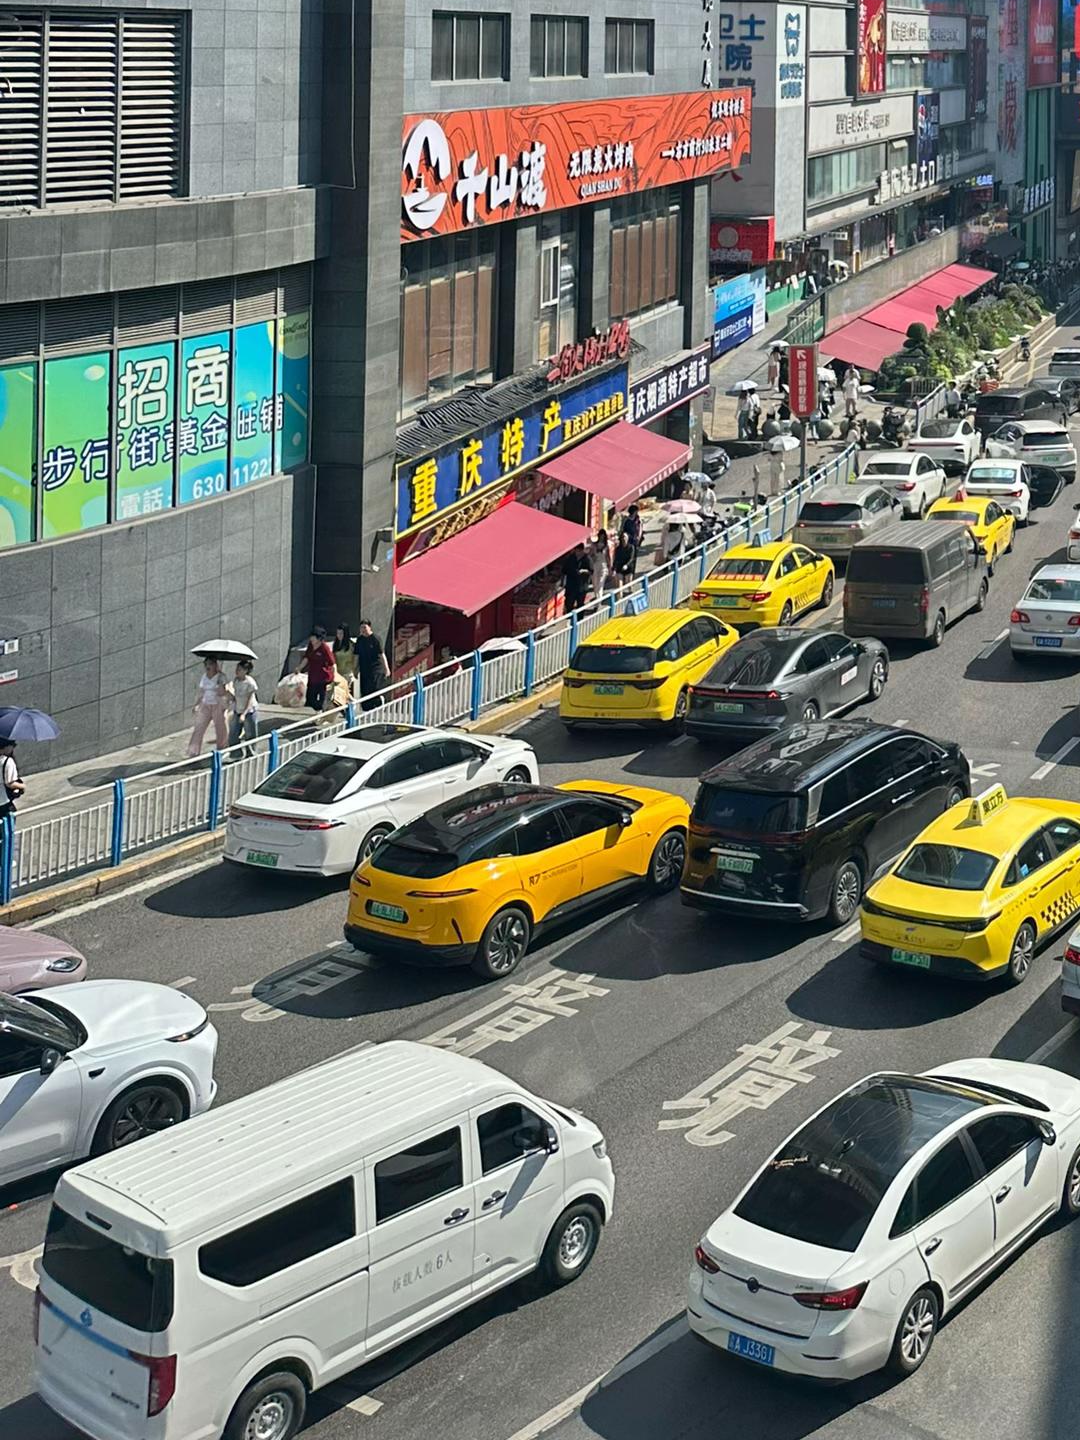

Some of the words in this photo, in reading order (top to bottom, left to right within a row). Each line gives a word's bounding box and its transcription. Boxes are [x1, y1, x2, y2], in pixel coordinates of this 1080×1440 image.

[719, 43, 752, 71] 院
[456, 141, 548, 224] 千山渡
[118, 345, 230, 428] 招商
[411, 400, 561, 523] 重庆特产
[657, 1021, 842, 1146] 境
